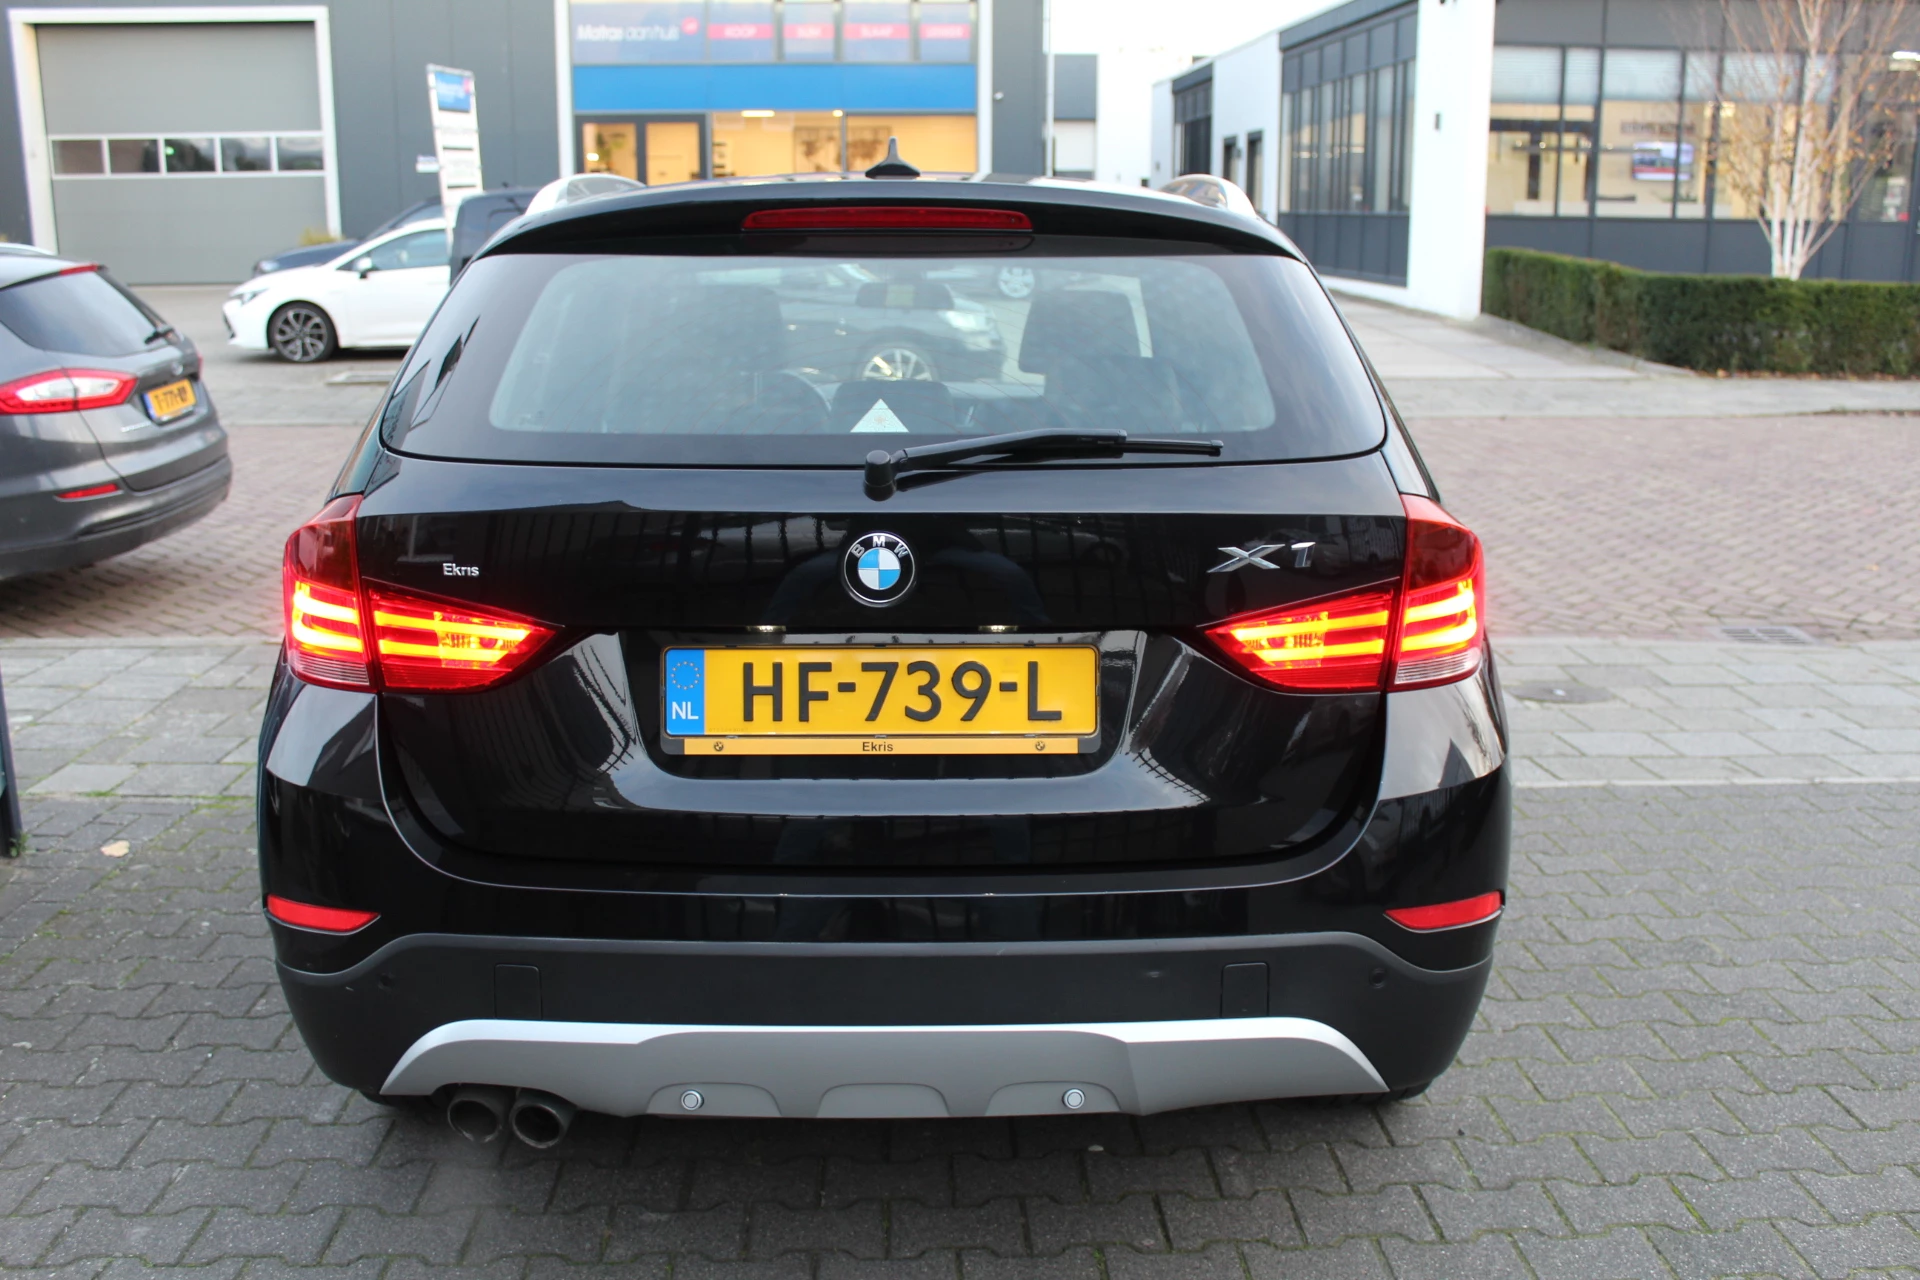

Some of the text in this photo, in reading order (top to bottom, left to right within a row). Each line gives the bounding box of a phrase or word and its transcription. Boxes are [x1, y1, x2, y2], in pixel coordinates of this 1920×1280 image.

[851, 535, 909, 559] BMW
[1206, 541, 1316, 573] X1
[442, 562, 480, 577] Ekris
[743, 660, 1062, 722] HF-739-L
[671, 701, 699, 720] NL
[861, 741, 895, 753] Ekris
